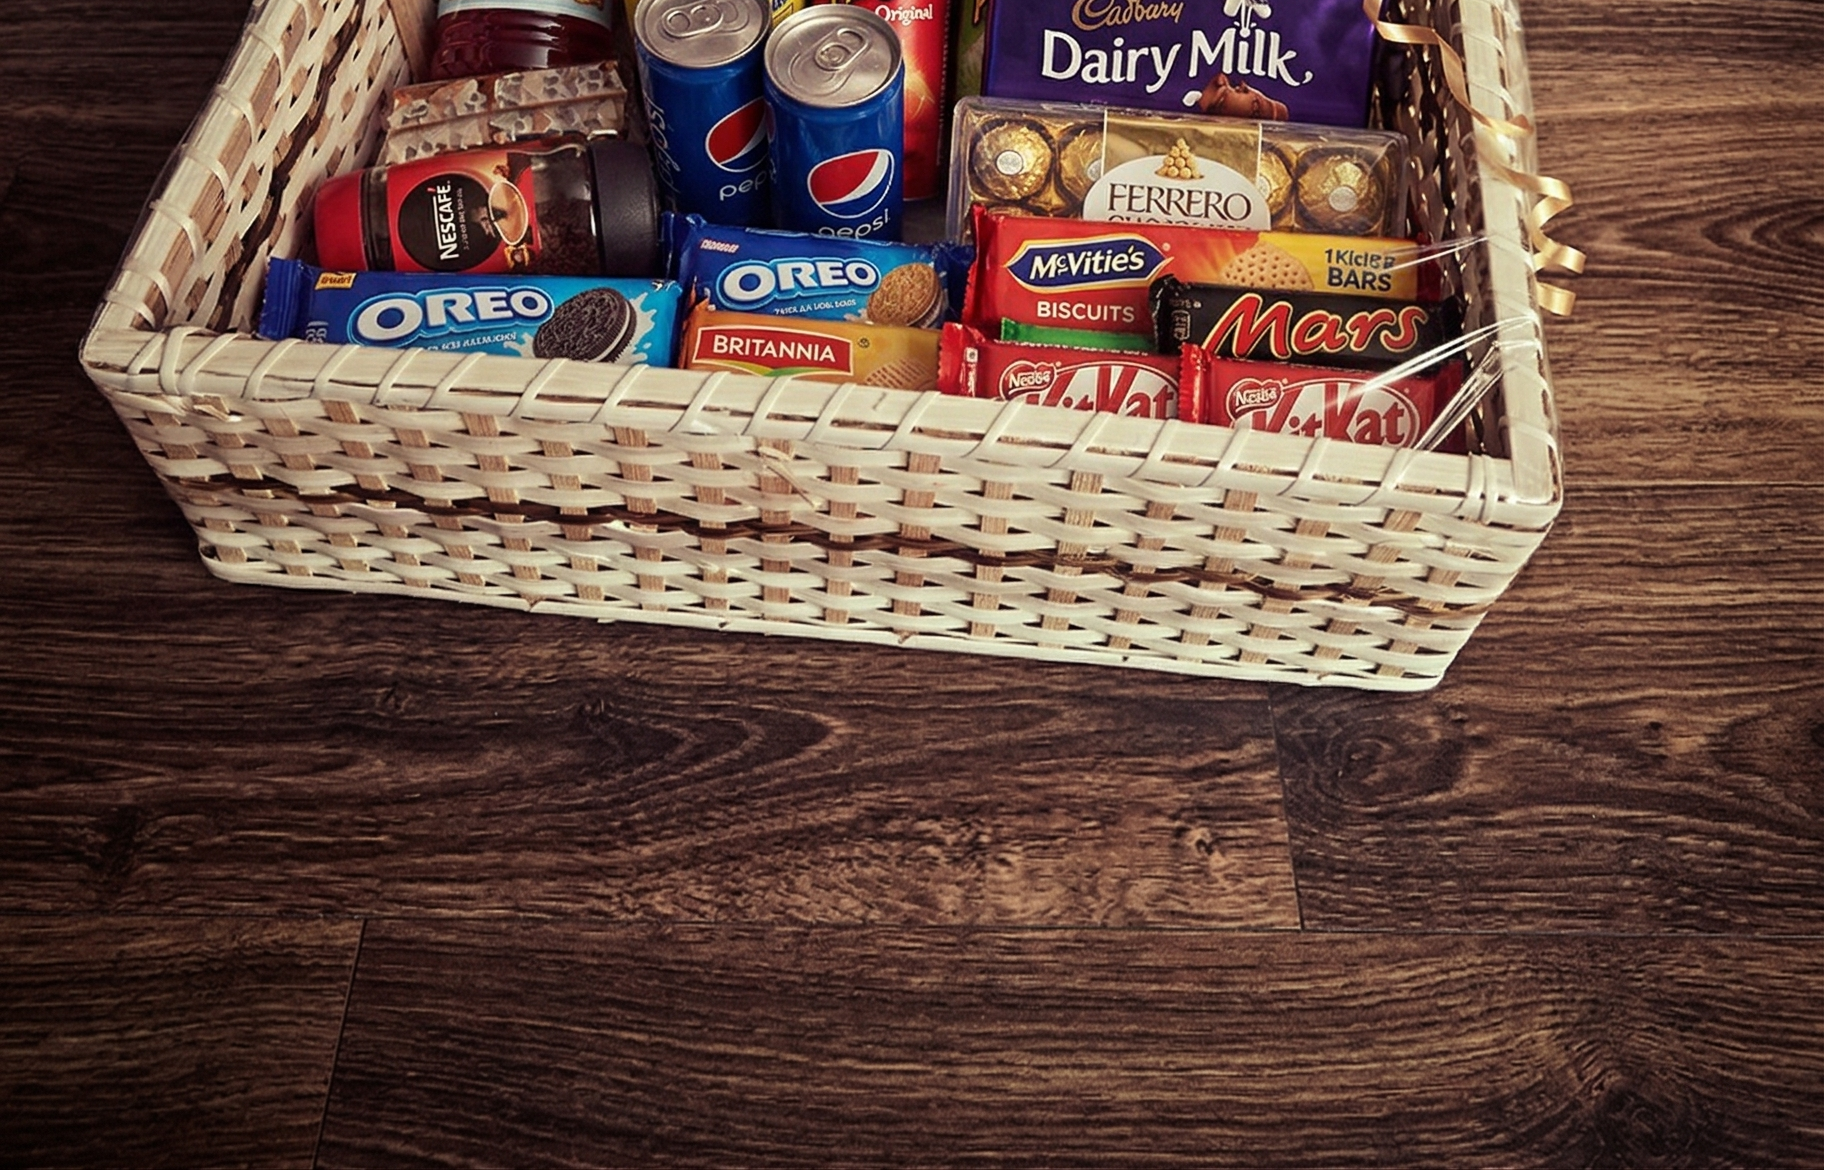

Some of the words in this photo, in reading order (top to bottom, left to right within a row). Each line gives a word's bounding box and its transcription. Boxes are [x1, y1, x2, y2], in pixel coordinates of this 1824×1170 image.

[875, 4, 933, 26] Original
[1041, 29, 1182, 93] Dairy
[1188, 26, 1301, 87] Milk
[719, 171, 769, 201] pep
[1107, 182, 1252, 221] FERRERO
[722, 261, 878, 302] OREO
[1029, 245, 1145, 280] McVitie's
[1327, 266, 1392, 292] BARS
[356, 289, 549, 341] OREO
[1036, 300, 1135, 323] BISCUITS
[1200, 293, 1428, 360] Mars
[712, 334, 836, 363] BRITANNIA
[1026, 365, 1174, 420] Kat
[1252, 382, 1405, 446] Kat
